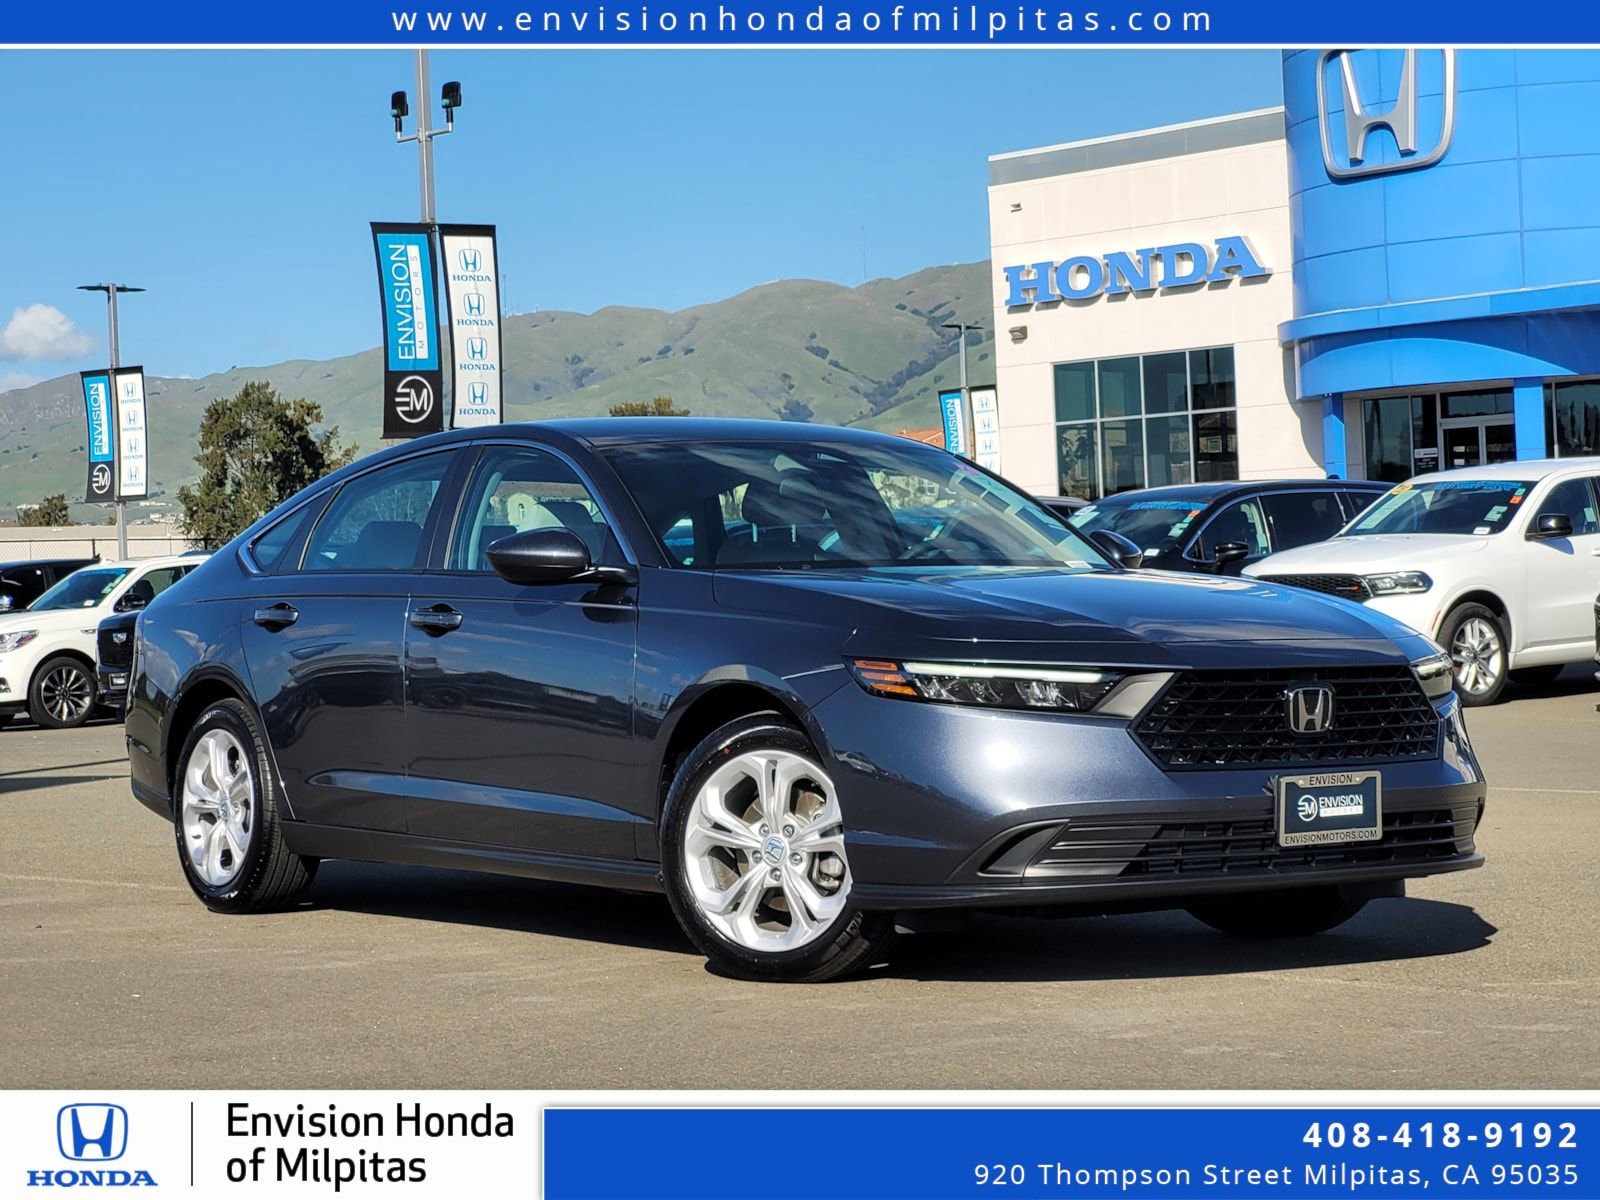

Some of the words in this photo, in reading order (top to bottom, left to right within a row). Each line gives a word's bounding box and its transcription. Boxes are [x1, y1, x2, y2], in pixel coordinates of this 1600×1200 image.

[453, 274, 492, 282] HONDA
[1003, 235, 1267, 307] HONDA
[389, 244, 415, 359] ENVISION
[411, 255, 425, 349] MOTORS
[456, 319, 495, 327] HONDA
[459, 363, 496, 371] HONDA
[459, 408, 496, 416] HONDA
[89, 383, 103, 456] ENVISION
[1309, 774, 1353, 786] ENVISION
[1319, 794, 1364, 808] ENVISION
[1284, 830, 1378, 845] ENVISIONMOTORS.COM
